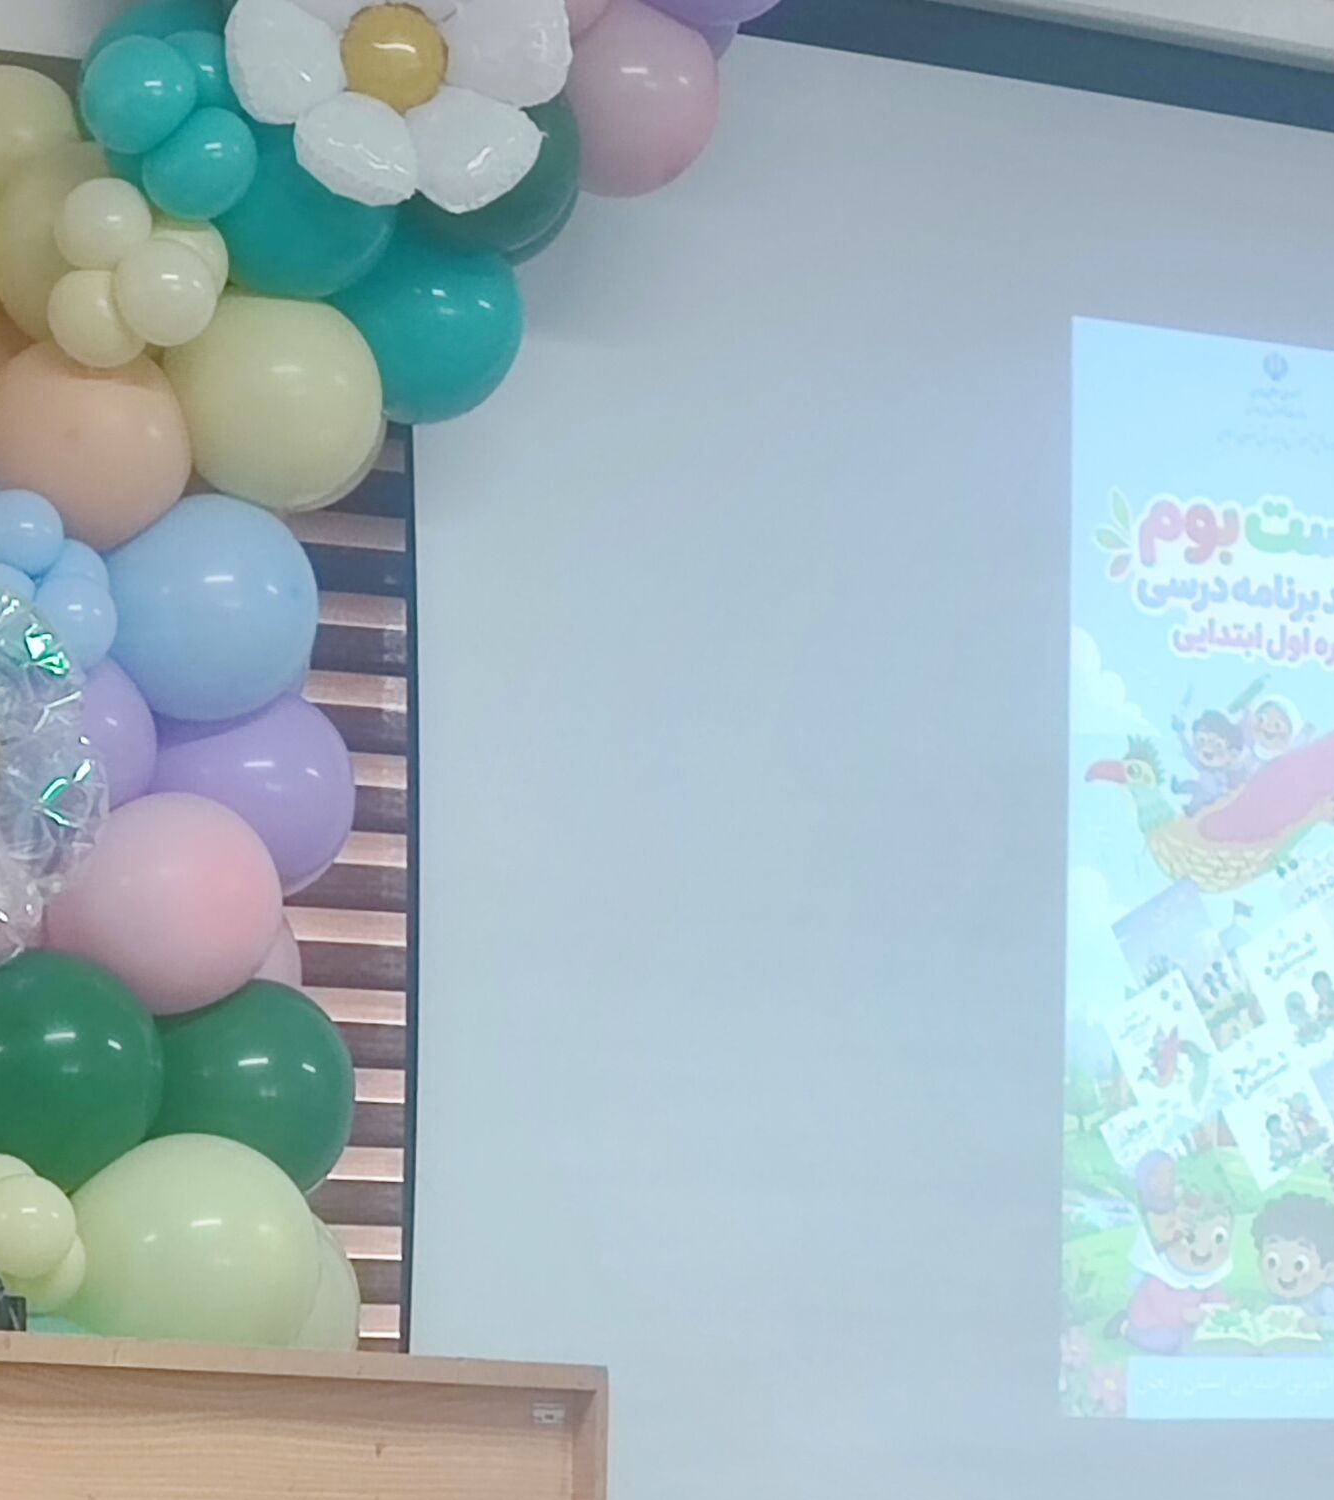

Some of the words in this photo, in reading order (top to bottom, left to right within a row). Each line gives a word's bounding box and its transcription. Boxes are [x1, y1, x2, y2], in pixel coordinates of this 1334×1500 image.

[1139, 500, 1240, 567] بوم
[1137, 575, 1228, 613] درسی
[1232, 573, 1320, 622] برنامه
[1173, 618, 1263, 657] ابتدایی
[1266, 624, 1310, 662] اول
